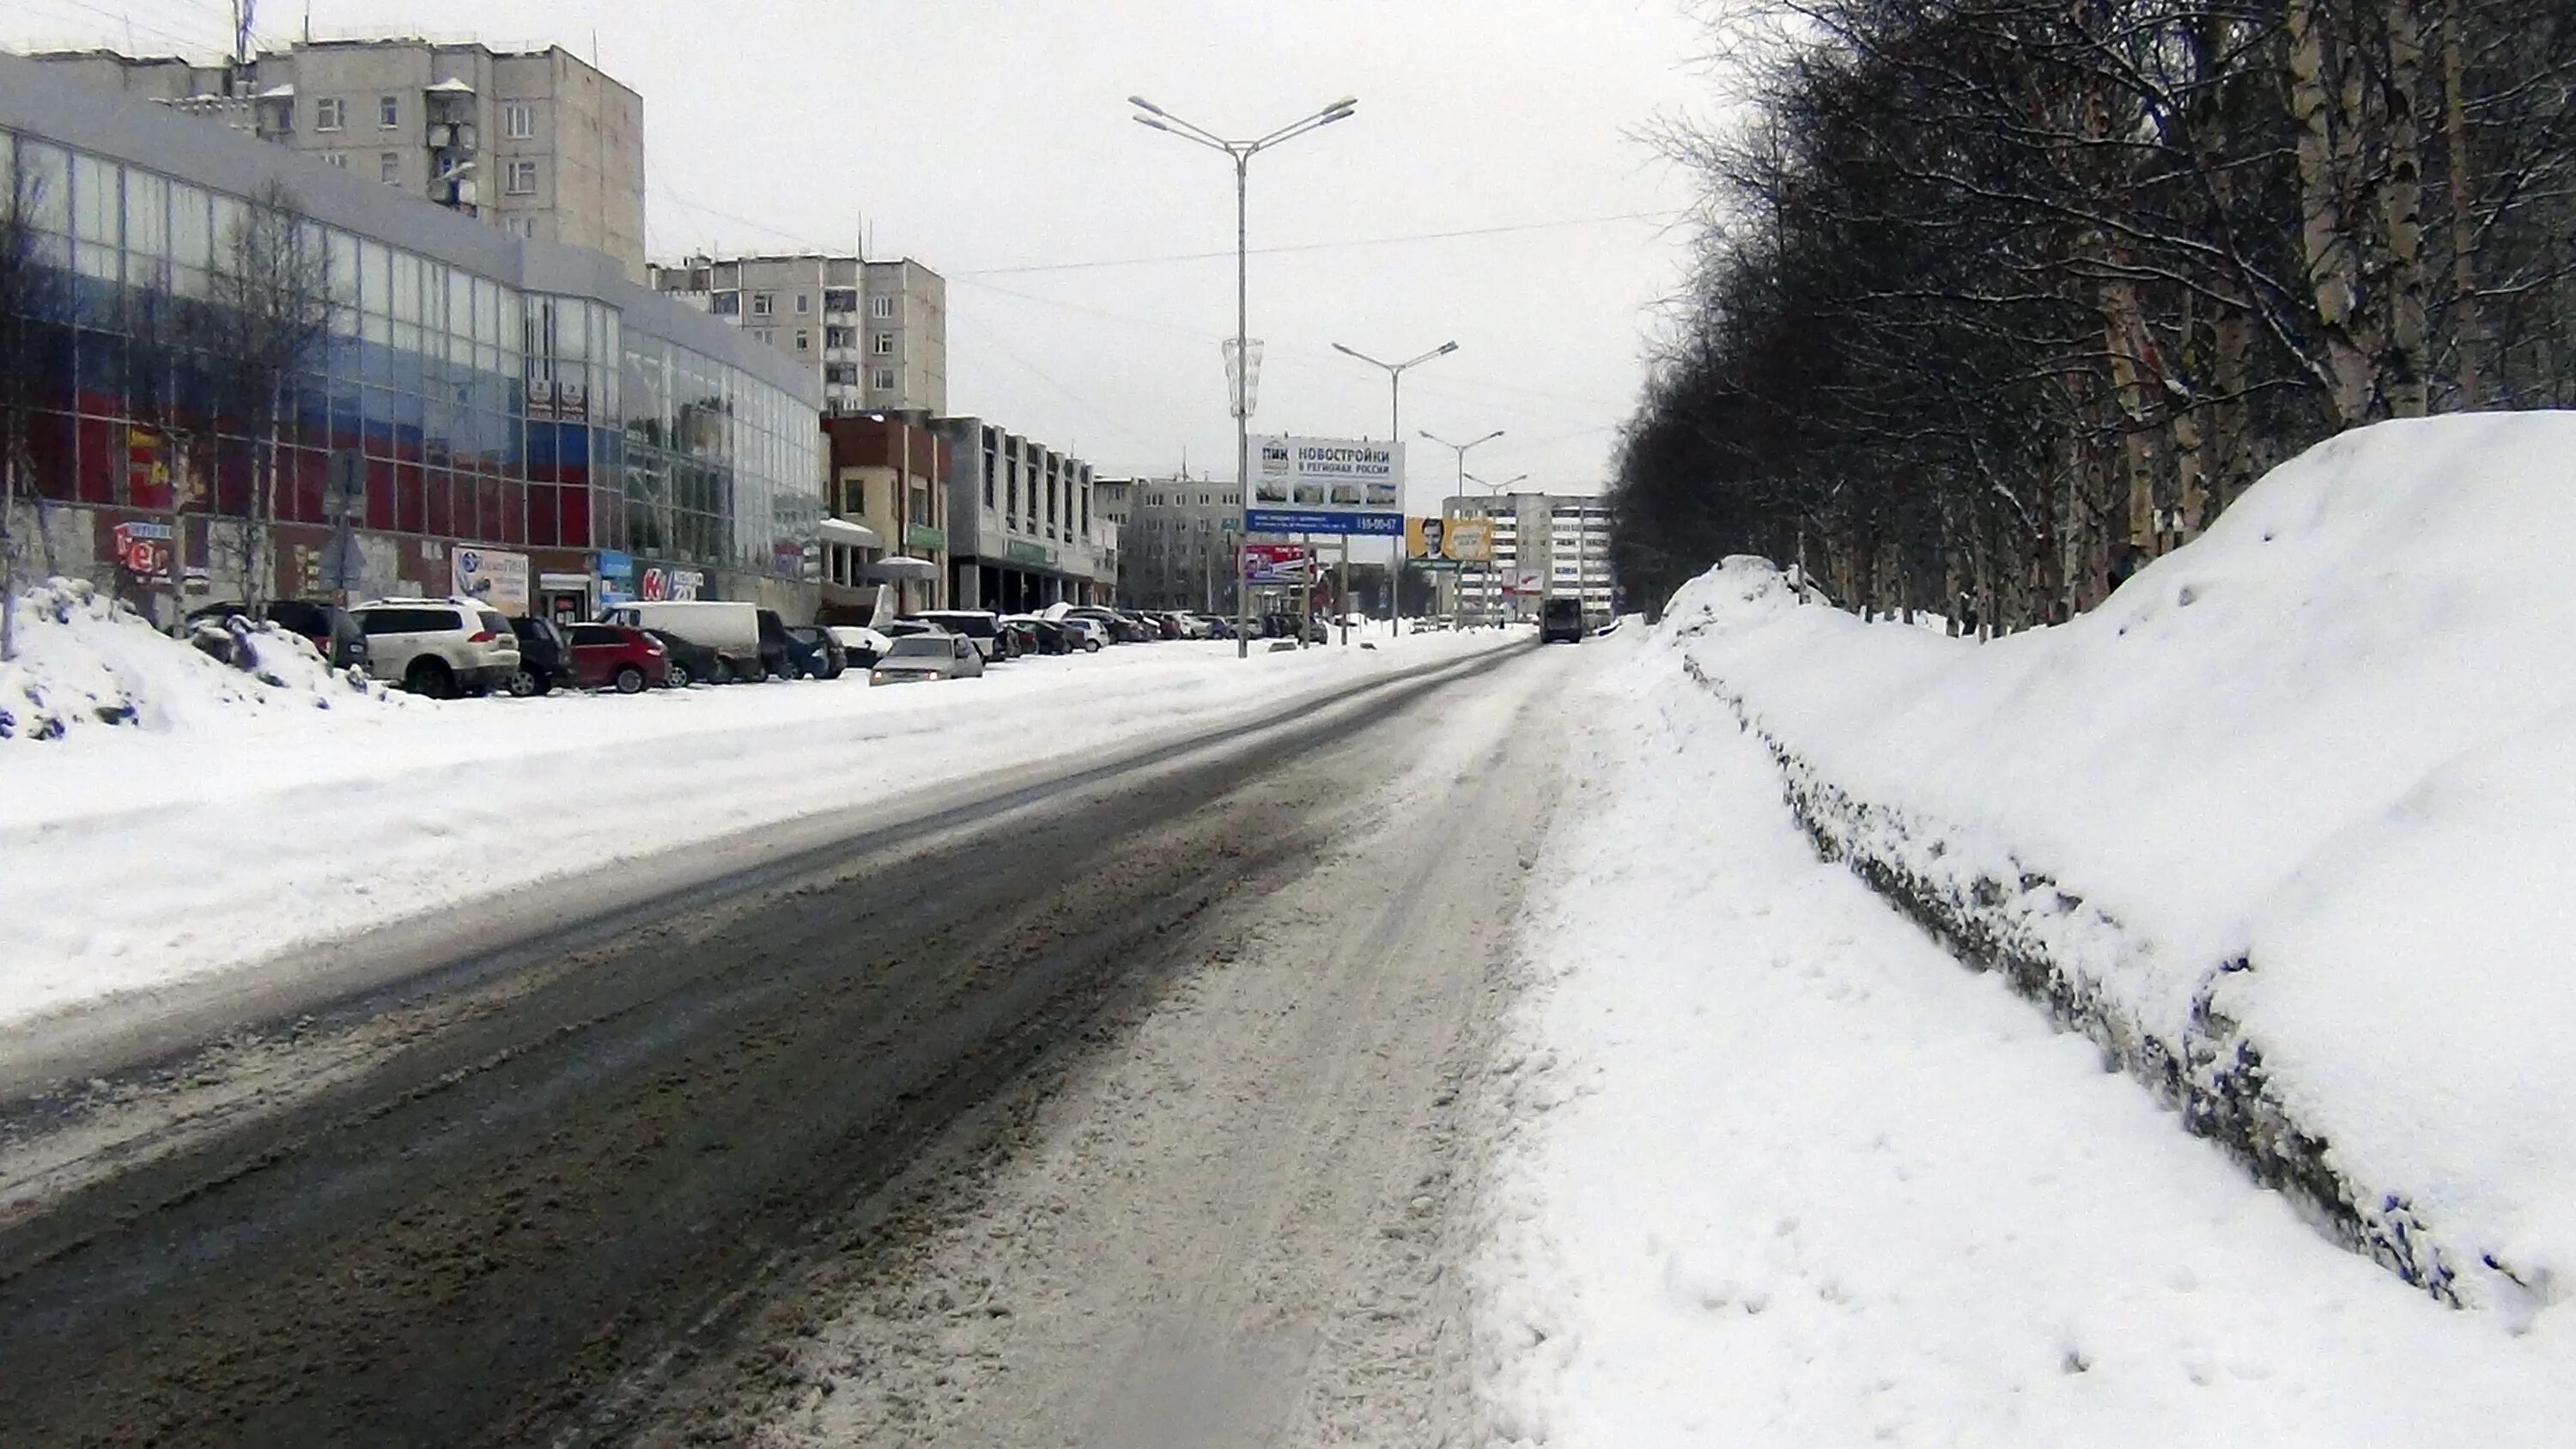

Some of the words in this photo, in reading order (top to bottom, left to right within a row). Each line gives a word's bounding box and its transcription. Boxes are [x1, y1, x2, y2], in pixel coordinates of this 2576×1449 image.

[1262, 447, 1289, 461] ПИК
[1298, 446, 1389, 463] НОВОСТРОЙКИ
[1307, 462, 1352, 472] РЕГИОНАХ
[1356, 464, 1389, 473] РОССИИ
